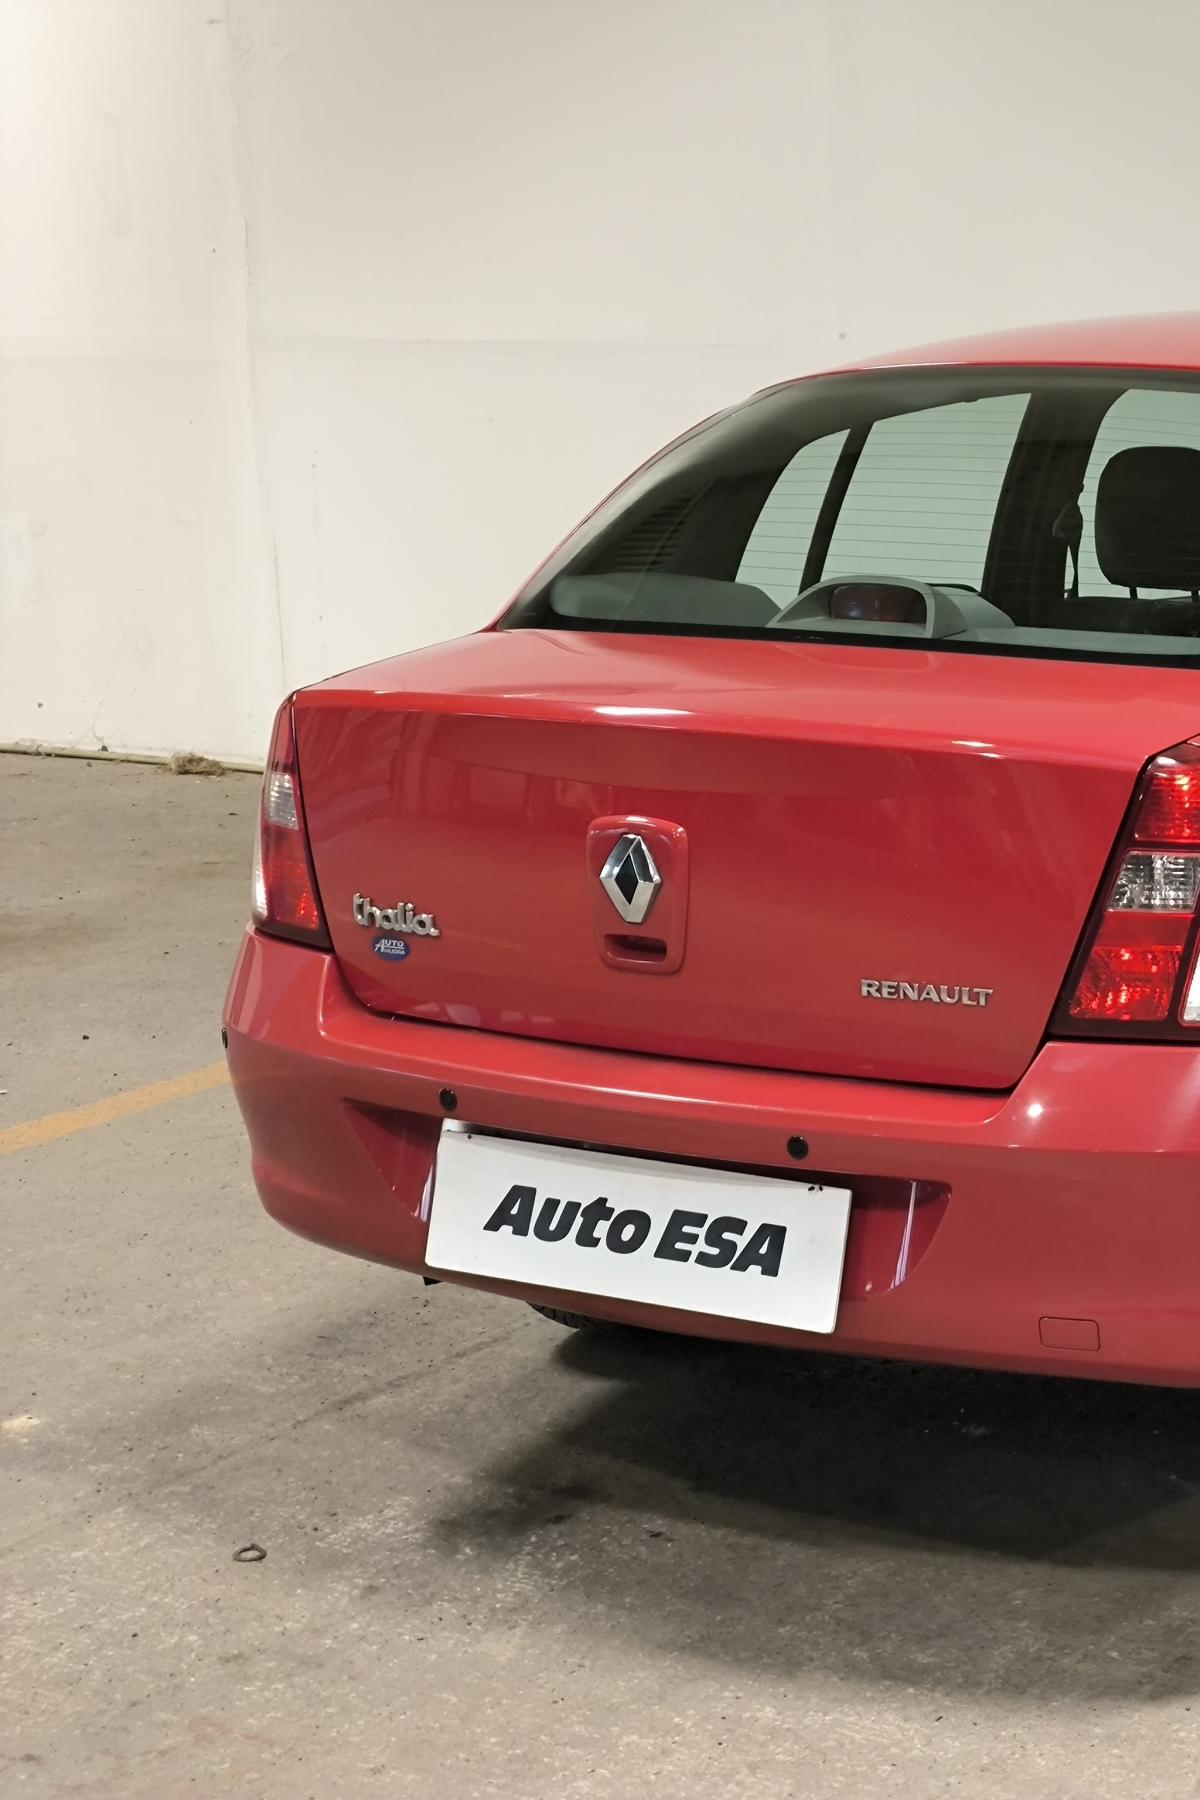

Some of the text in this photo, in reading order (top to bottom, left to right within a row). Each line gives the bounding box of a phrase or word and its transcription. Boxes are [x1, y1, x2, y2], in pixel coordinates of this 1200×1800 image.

[353, 892, 440, 937] thalia
[860, 979, 994, 1007] RENAULT
[483, 1184, 787, 1278] Auto ESA
